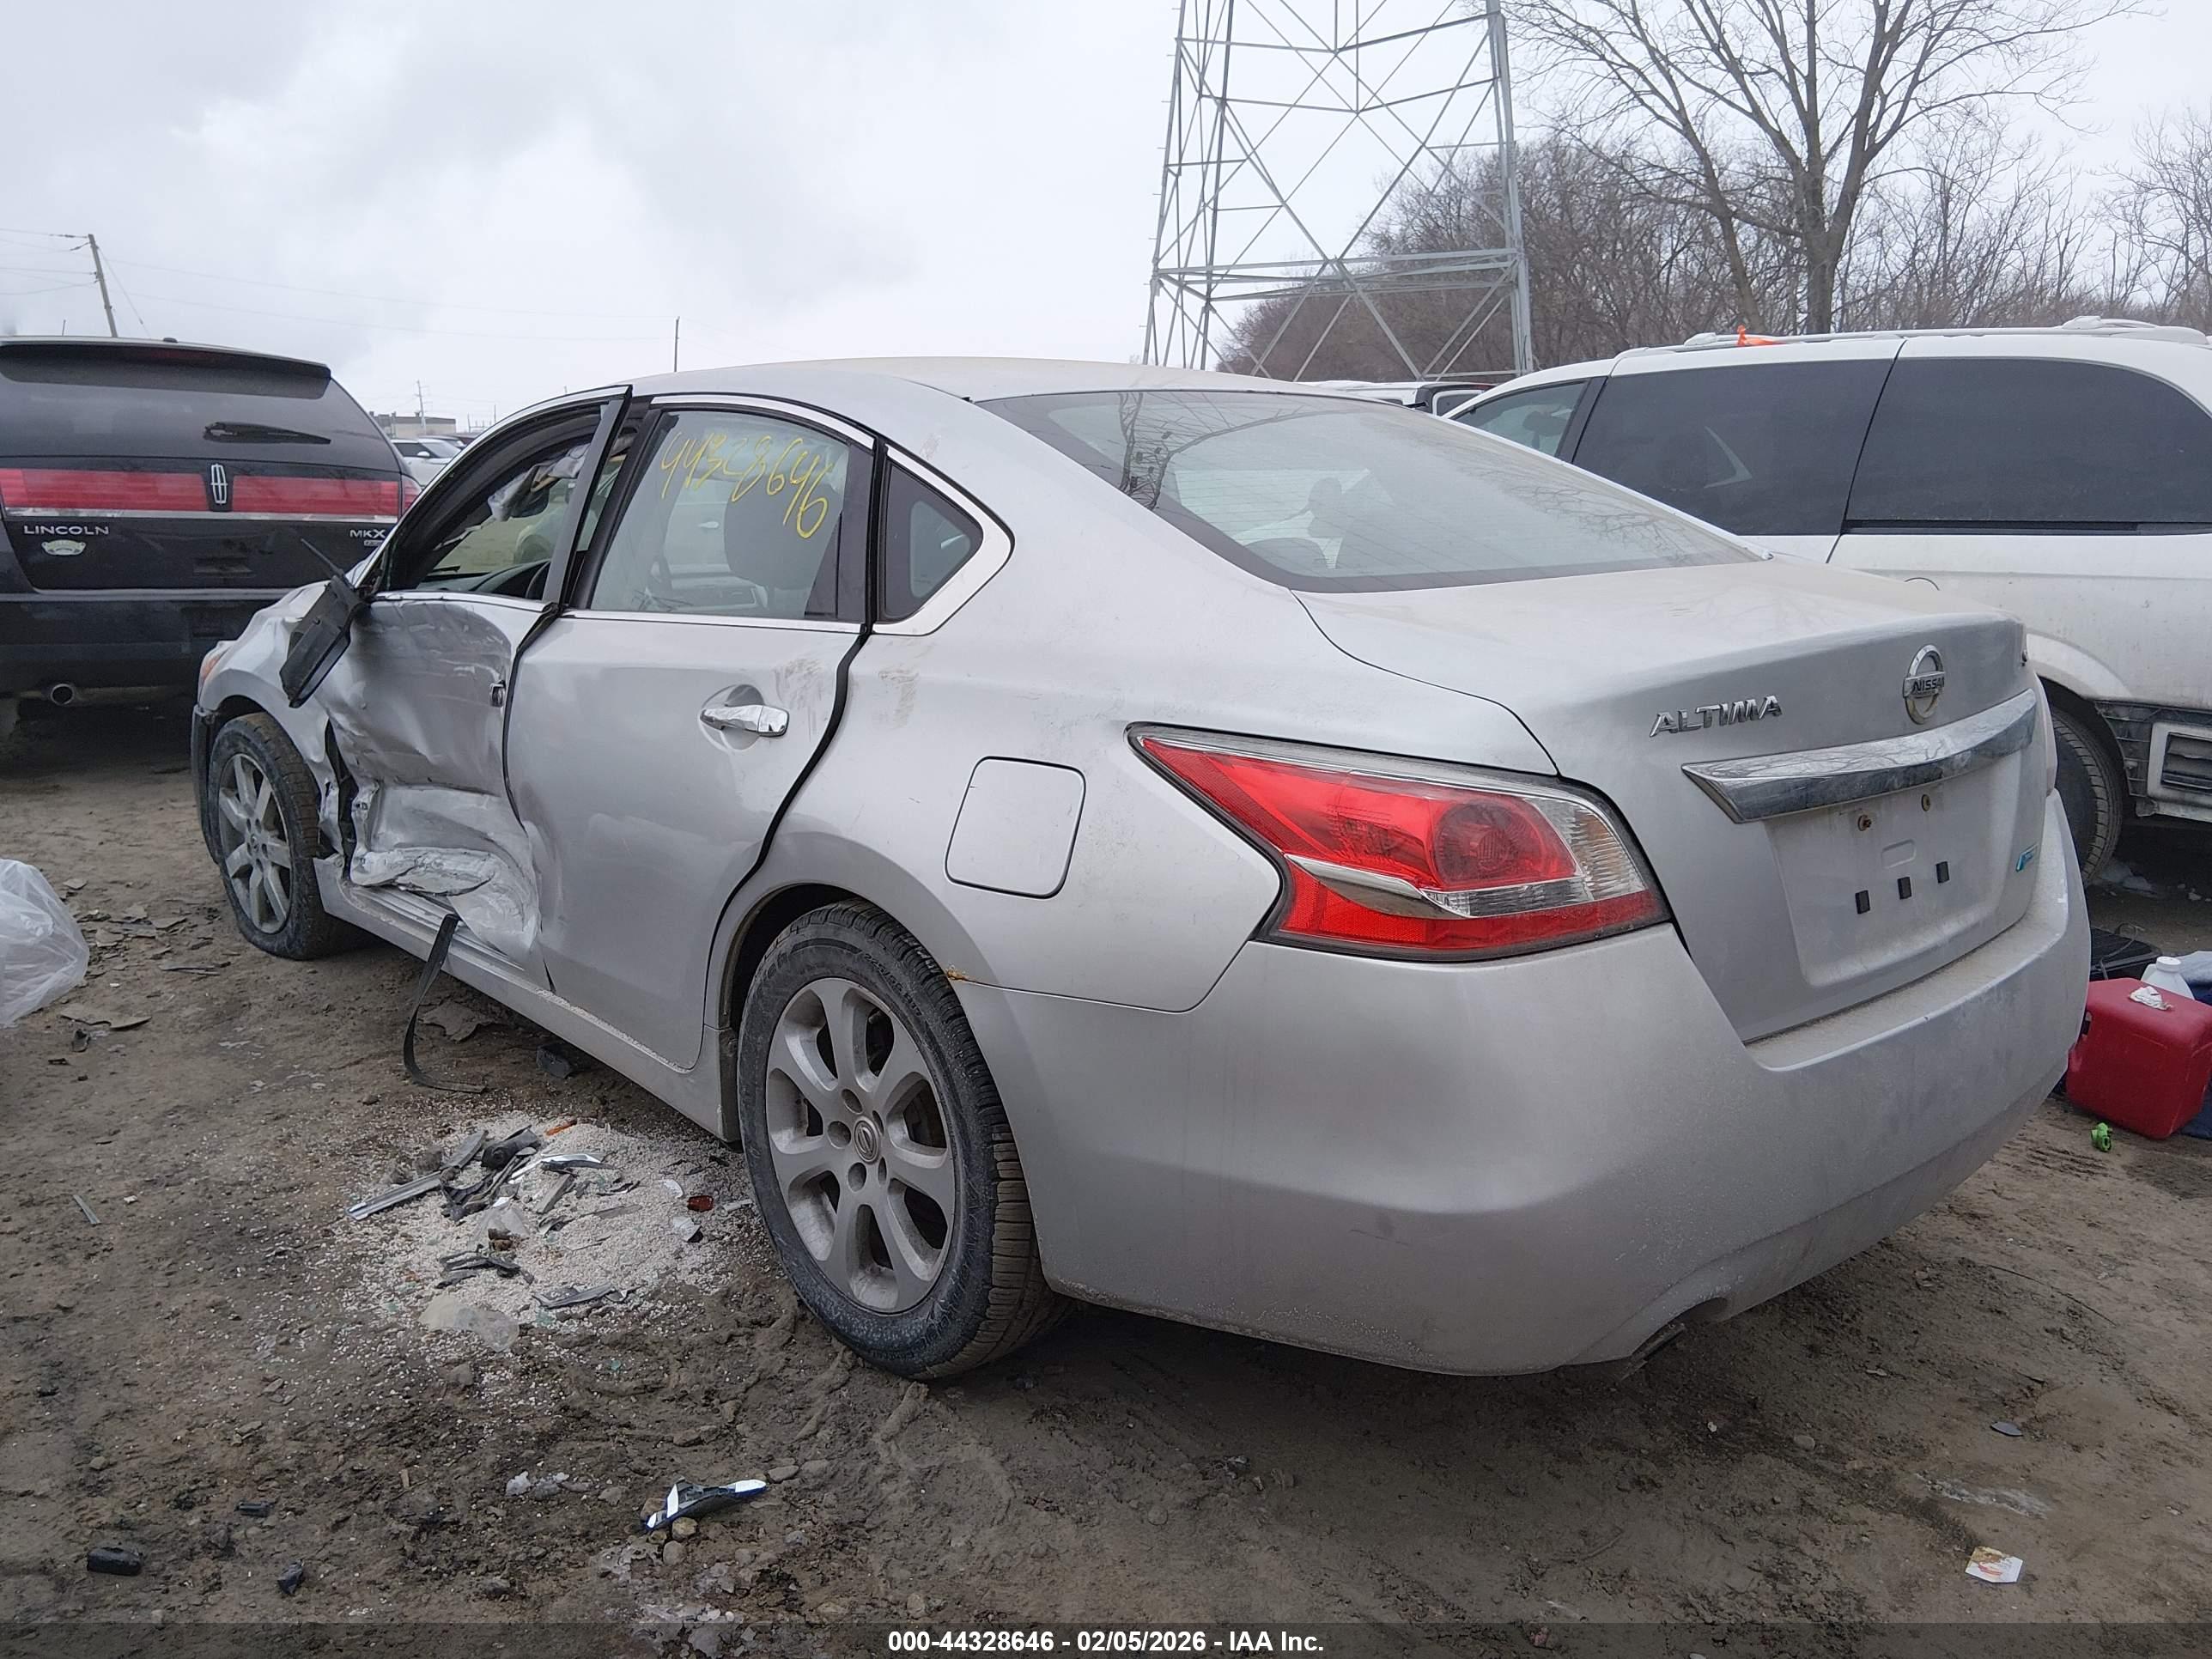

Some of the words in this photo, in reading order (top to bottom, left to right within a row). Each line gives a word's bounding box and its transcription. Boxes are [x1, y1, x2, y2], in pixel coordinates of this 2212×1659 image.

[23, 525, 109, 535] LINCOLN
[349, 528, 386, 539] MKX
[1650, 695, 1783, 738] ALTIMA
